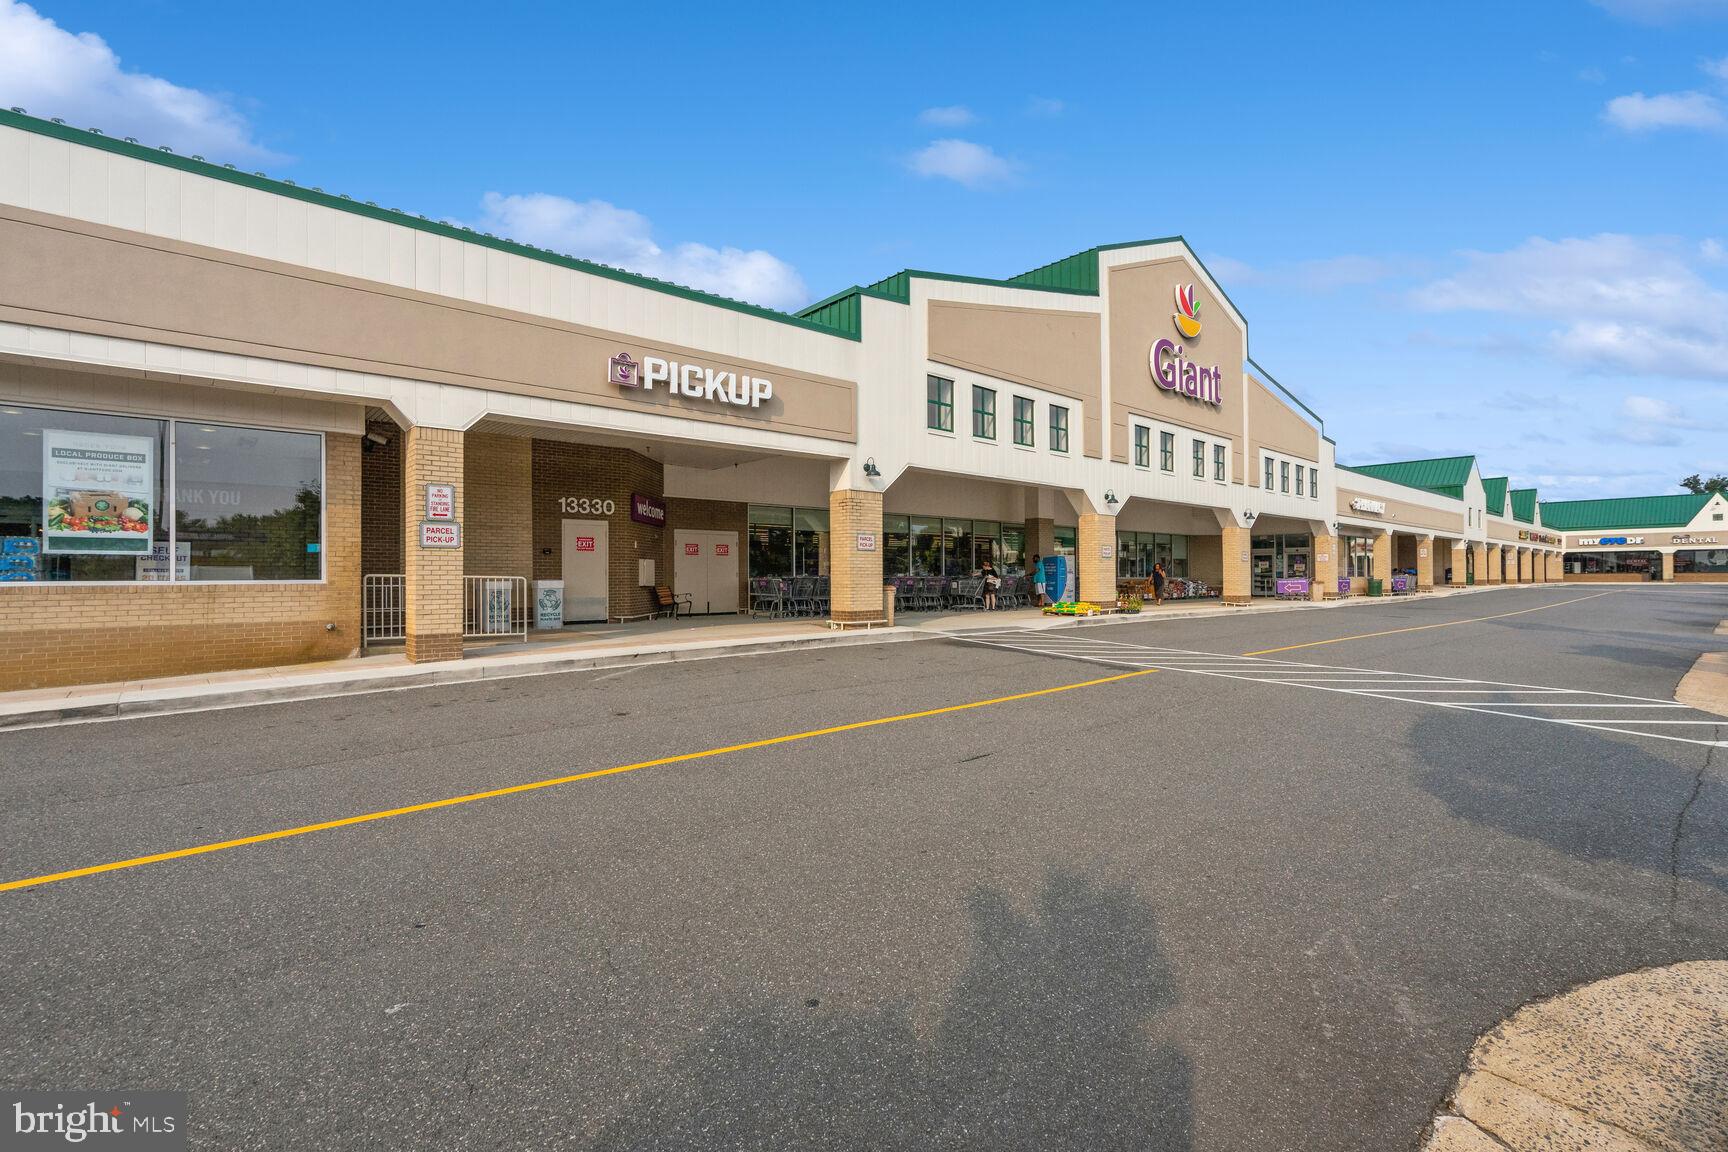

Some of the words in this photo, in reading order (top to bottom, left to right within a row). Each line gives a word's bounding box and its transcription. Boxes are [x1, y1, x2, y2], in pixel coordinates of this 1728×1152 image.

[1149, 338, 1223, 406] Giant
[643, 356, 772, 408] PICKUP
[85, 452, 124, 461] PRODUCE
[208, 489, 240, 505] YOU
[558, 497, 615, 515] 13330
[637, 501, 664, 520] welcome
[577, 540, 594, 548] EXIT
[1672, 537, 1719, 545] DENTAL
[140, 554, 188, 562] CHECKUT
